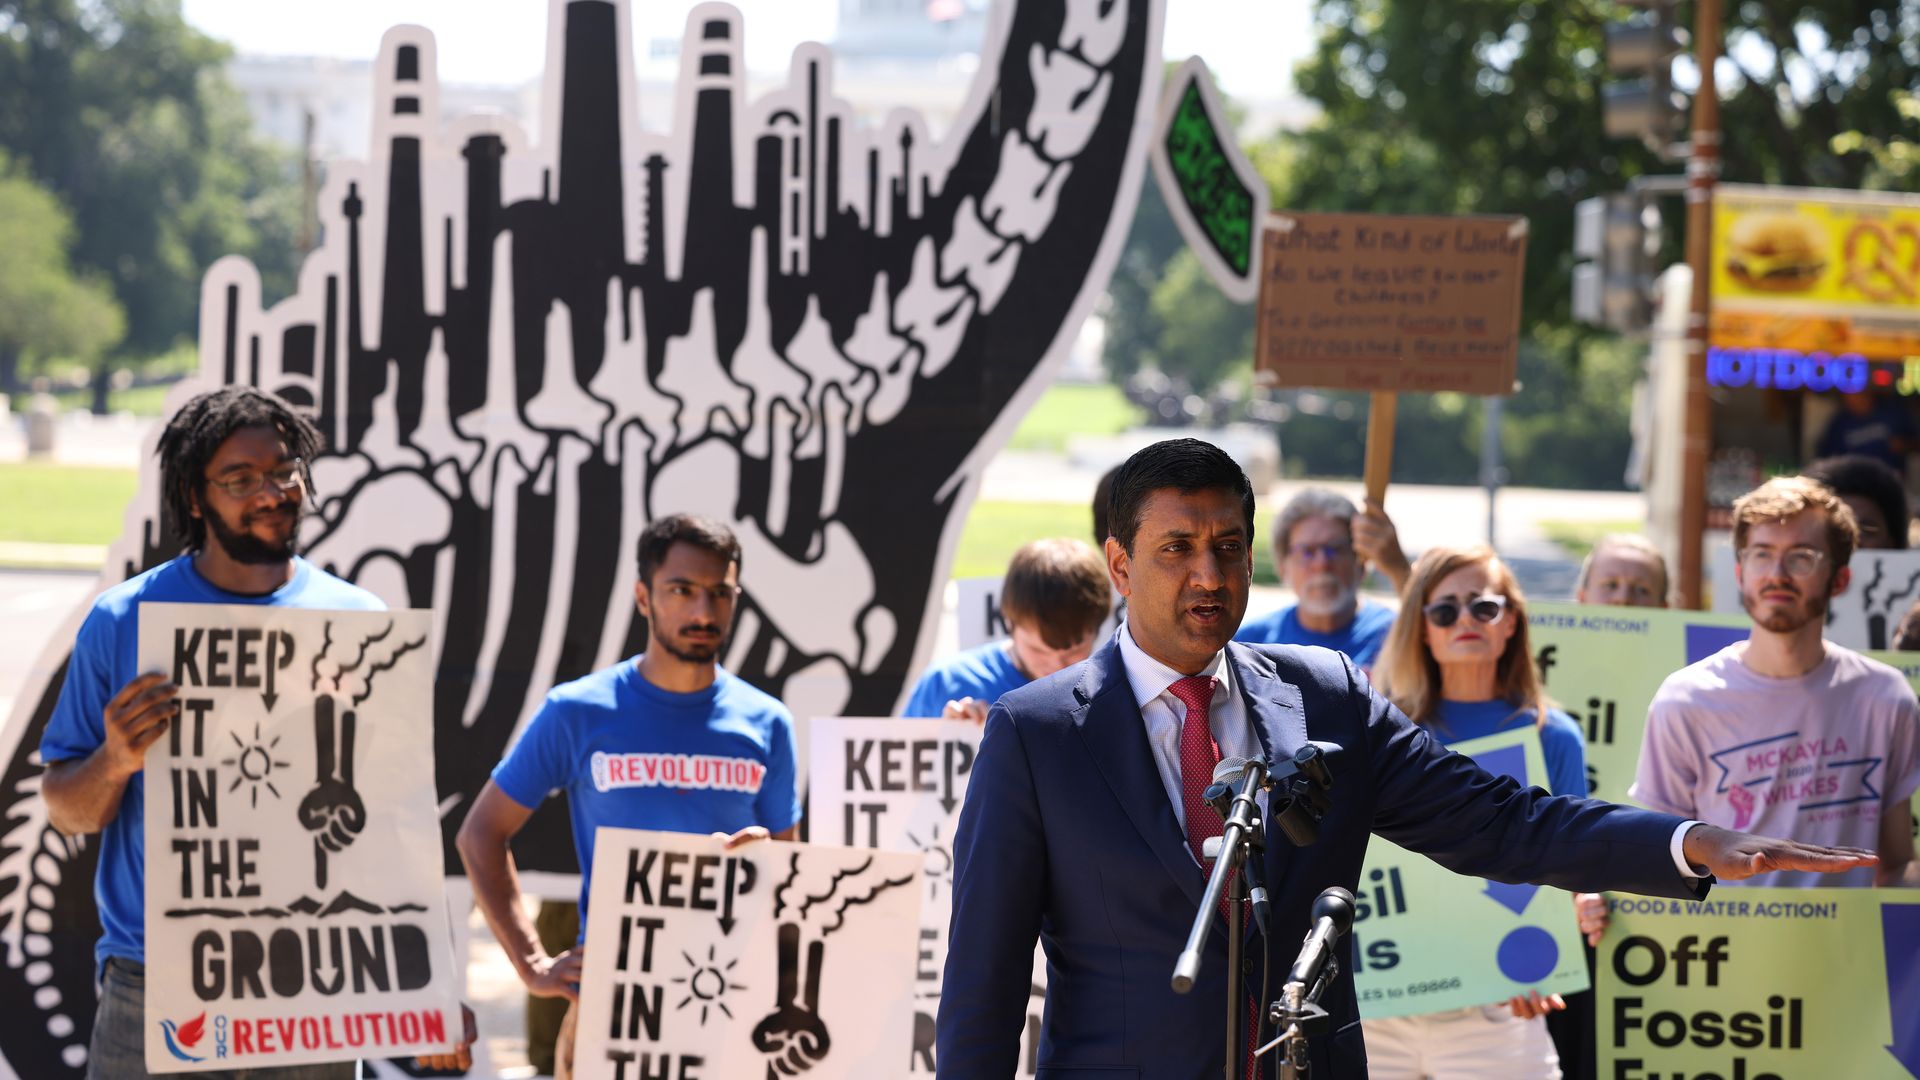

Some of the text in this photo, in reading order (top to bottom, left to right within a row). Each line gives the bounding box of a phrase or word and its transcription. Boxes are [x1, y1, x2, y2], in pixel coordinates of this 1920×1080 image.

[173, 628, 295, 713] KEEP
[170, 698, 214, 758] IT
[1746, 736, 1848, 773] MCKAYLA
[171, 768, 218, 829] IN
[608, 757, 763, 791] REVOLUTION
[845, 739, 974, 814] KEEP
[1763, 775, 1839, 805] WILKES
[844, 803, 887, 848] IT
[171, 838, 261, 899] THE
[624, 848, 757, 936] KEEP
[1609, 898, 1838, 920] FOOD & WATER ACTION!
[191, 923, 432, 1001] GROUND
[616, 915, 665, 973] IT
[1612, 935, 1730, 987] Off
[214, 1008, 446, 1059] OUR REVOLUTION
[609, 983, 664, 1042] IN
[1613, 995, 1804, 1050] Fossil
